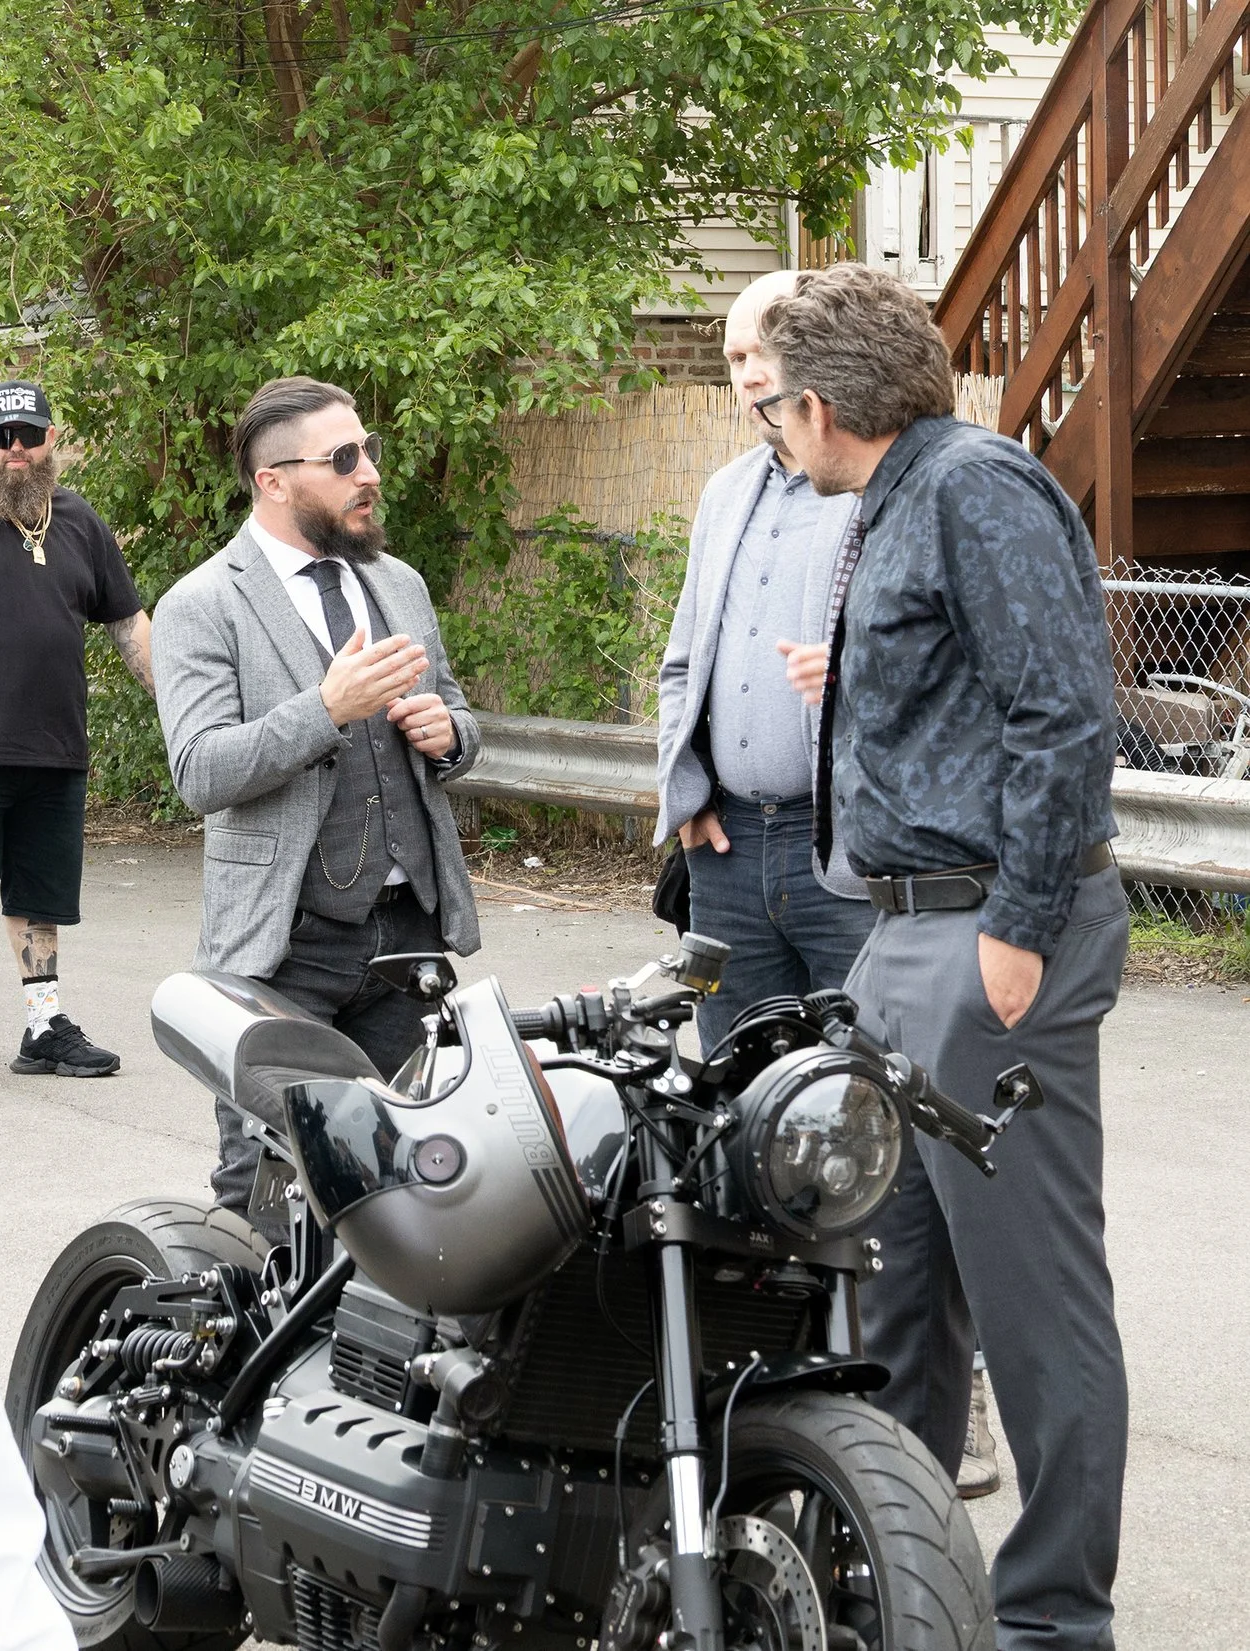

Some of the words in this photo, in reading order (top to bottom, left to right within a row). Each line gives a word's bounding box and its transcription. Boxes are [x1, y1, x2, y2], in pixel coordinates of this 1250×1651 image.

[479, 1044, 557, 1166] BULLITT
[749, 1231, 770, 1244] JAX
[300, 1479, 361, 1519] BMW
